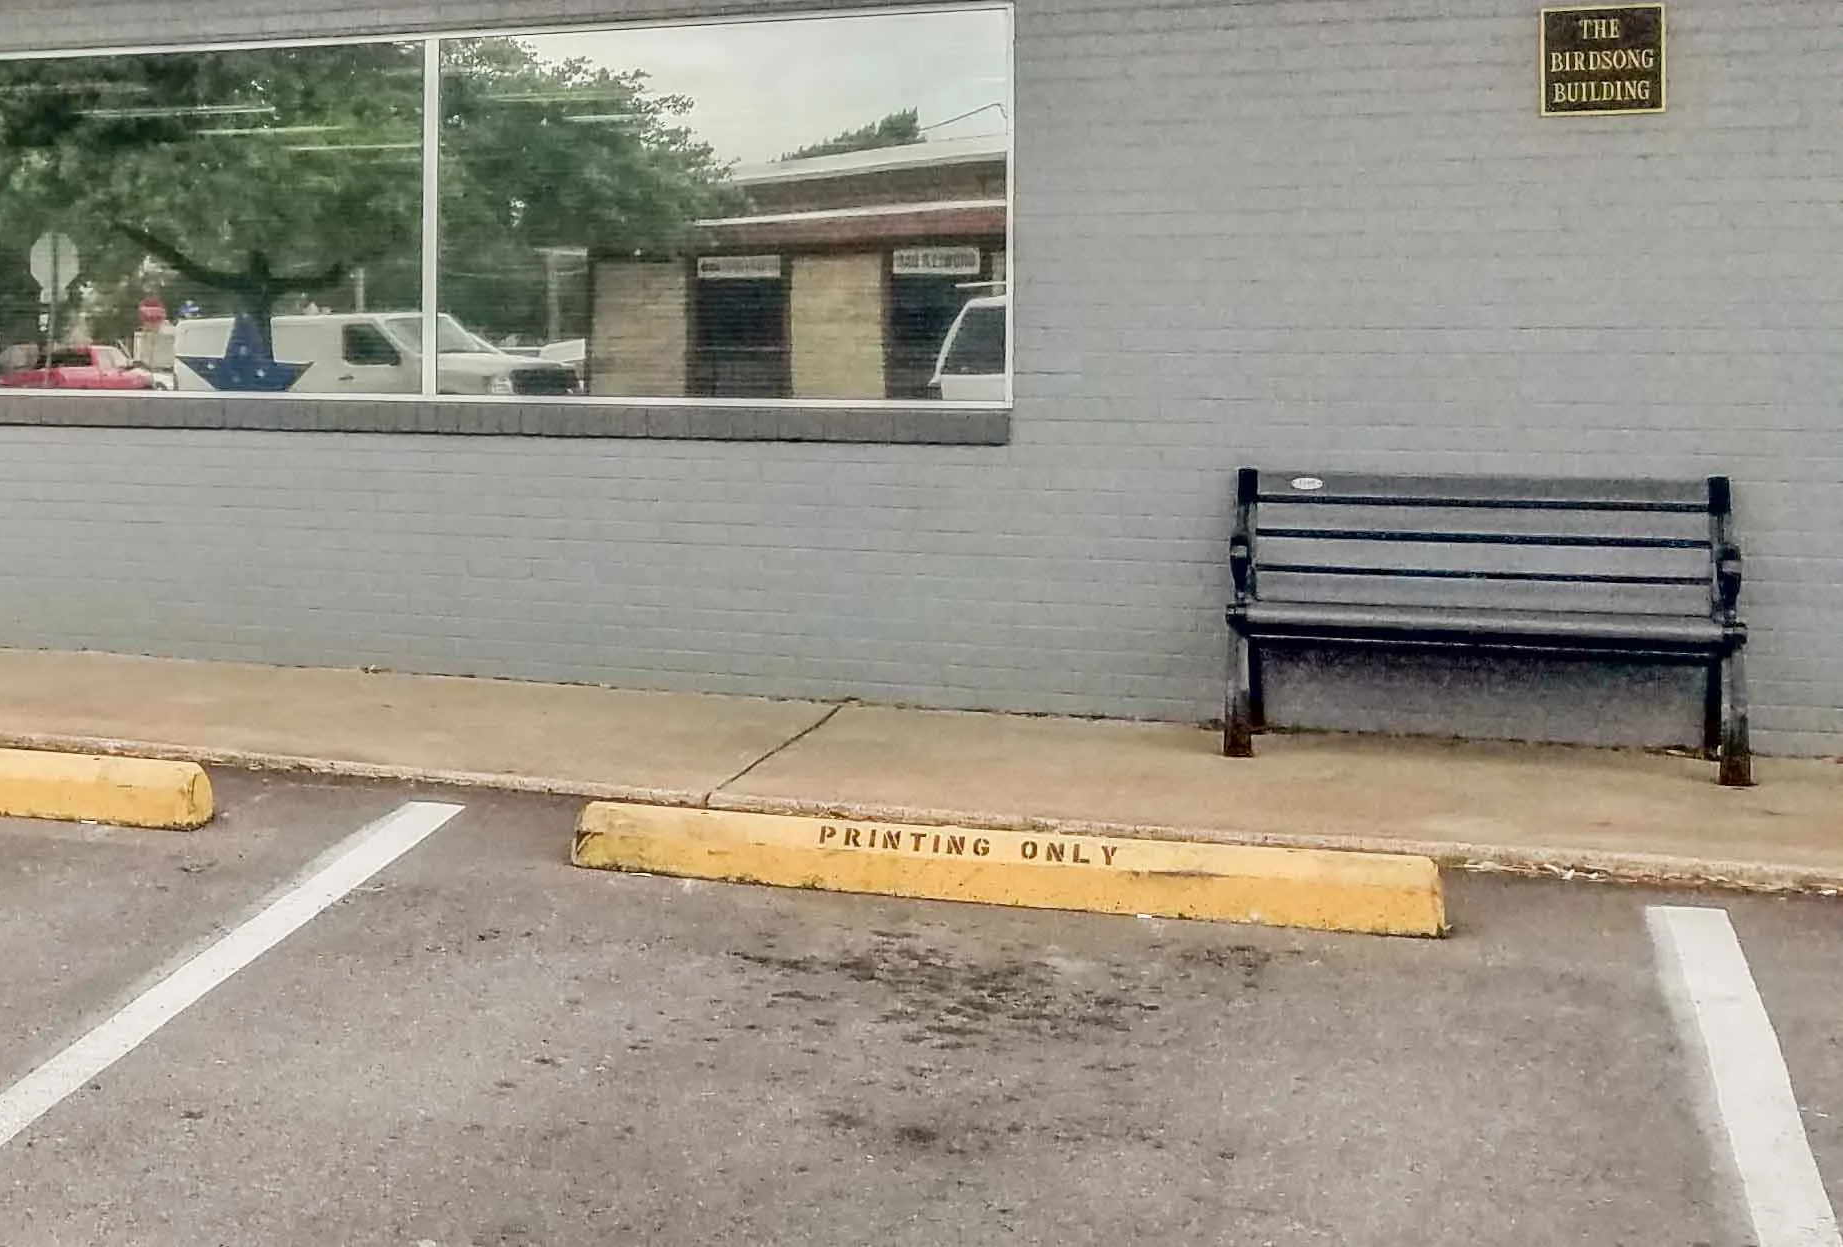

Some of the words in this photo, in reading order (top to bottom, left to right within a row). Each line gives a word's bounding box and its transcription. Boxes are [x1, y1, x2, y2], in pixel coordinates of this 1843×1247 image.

[1578, 17, 1621, 40] THE
[1550, 48, 1655, 73] BIRDSONG
[1552, 79, 1651, 103] BUILDING
[817, 825, 991, 857] PRINTING
[1020, 839, 1118, 866] ONLY
